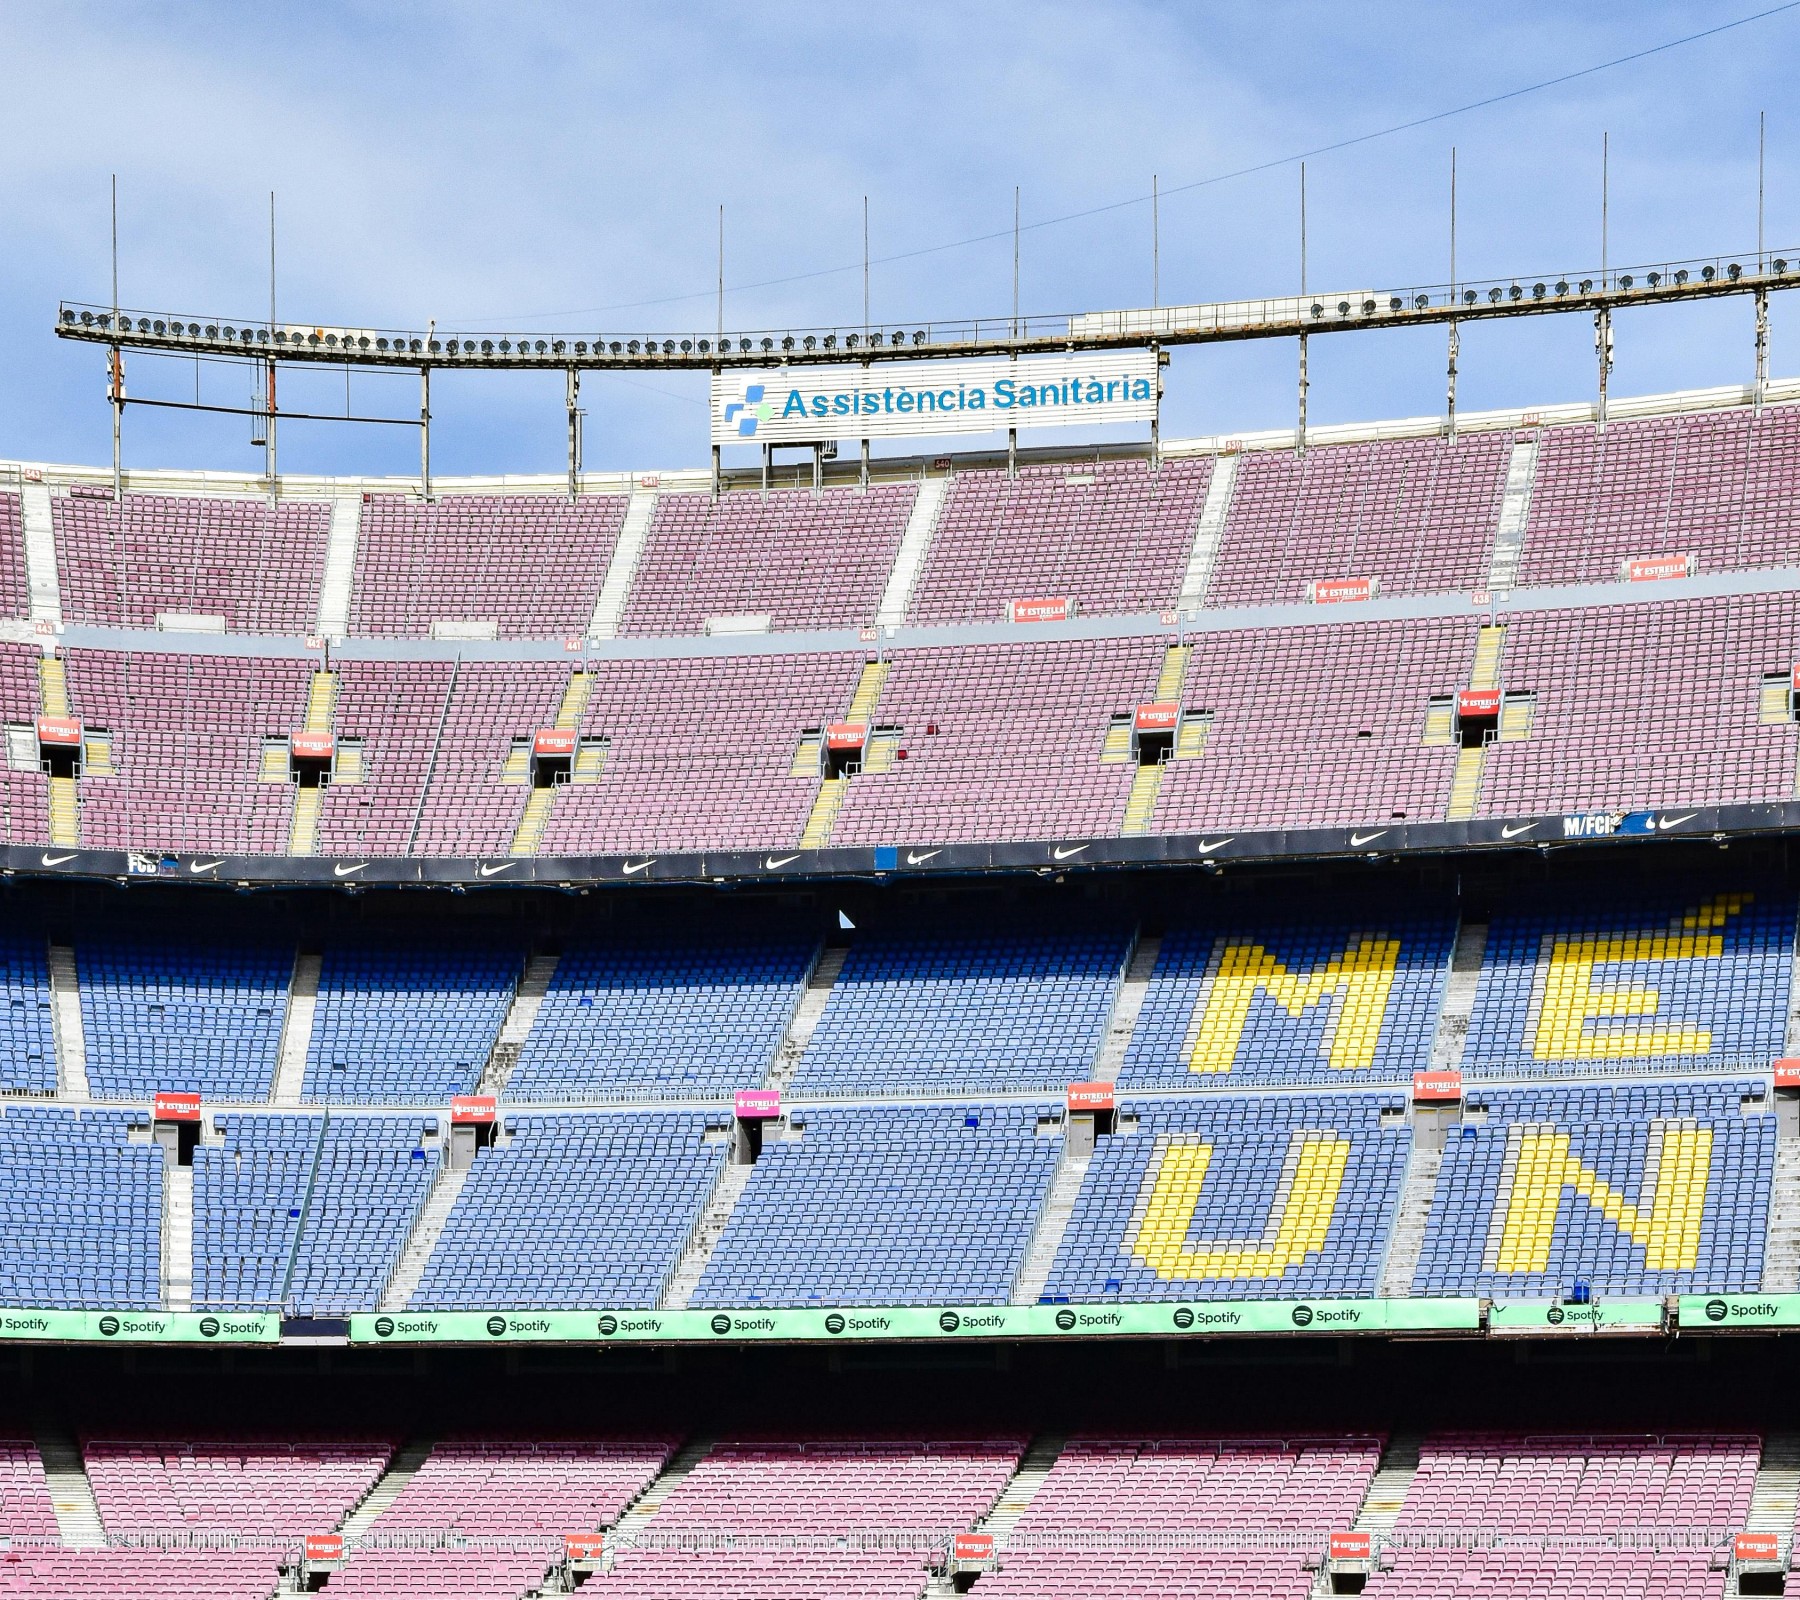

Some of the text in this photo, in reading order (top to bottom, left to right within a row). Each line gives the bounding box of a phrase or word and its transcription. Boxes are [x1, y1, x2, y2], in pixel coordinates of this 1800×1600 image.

[782, 374, 1152, 418] Assistència Sanitària
[936, 460, 950, 468] 540
[1645, 564, 1685, 575] ESTRELLA
[1330, 587, 1369, 596] ESTRELLA
[1473, 594, 1489, 604] 438
[1027, 606, 1065, 615] ESTRELLA
[1162, 614, 1177, 624] 439
[37, 624, 53, 634] 443
[861, 630, 877, 640] 440
[567, 641, 580, 650] 441
[1079, 1092, 1112, 1100] ESTRELLA
[166, 1102, 199, 1110] ESTRELLA
[1133, 1138, 1713, 1280] UN
[1316, 1309, 1361, 1323] Spotify
[1567, 1310, 1603, 1322] Spotify
[1731, 1303, 1778, 1318] Spotify
[6, 1318, 48, 1332] Spotify
[620, 1319, 662, 1332] Spotify
[734, 1318, 776, 1331] Spotify
[848, 1317, 890, 1330] Spotify
[963, 1315, 1005, 1329] Spotify
[1079, 1313, 1122, 1327] Spotify
[1198, 1312, 1241, 1326] Spotify
[123, 1320, 166, 1334] Spotify
[223, 1323, 265, 1337] Spotify
[397, 1320, 438, 1334] Spotify
[510, 1320, 551, 1333] Spotify
